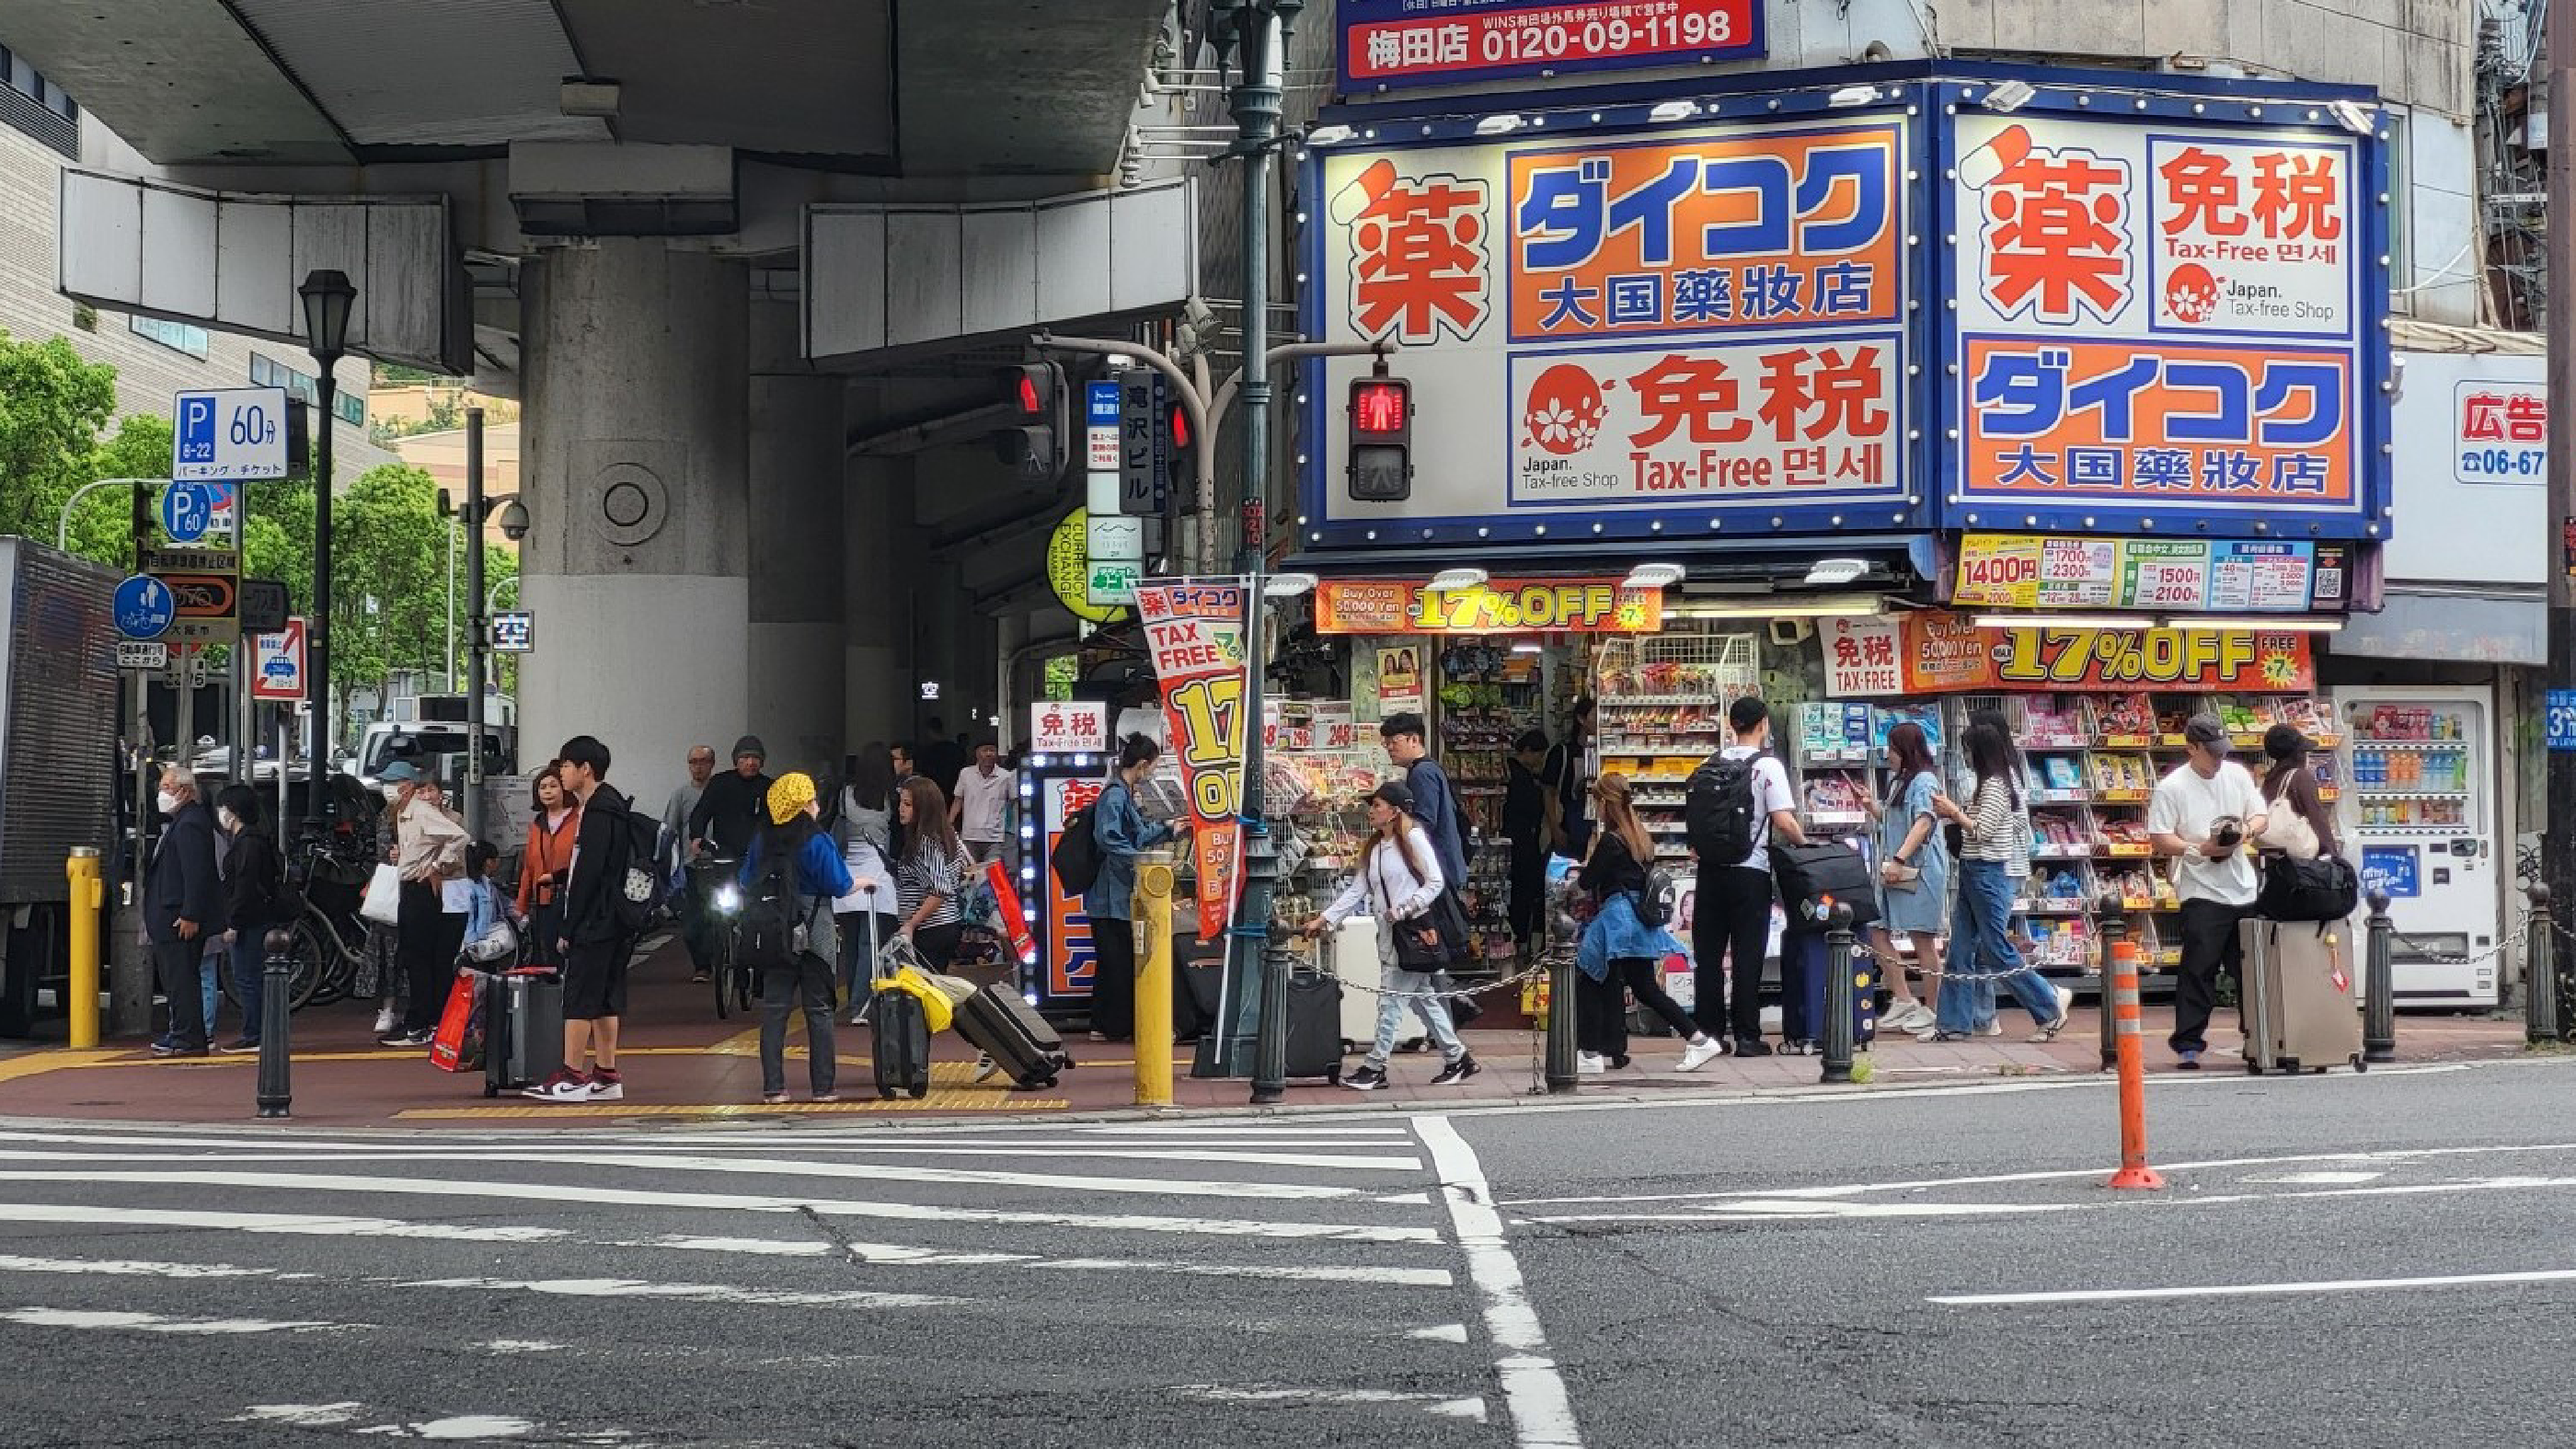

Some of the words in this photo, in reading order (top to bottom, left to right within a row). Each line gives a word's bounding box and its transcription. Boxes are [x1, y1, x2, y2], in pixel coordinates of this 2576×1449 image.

[1367, 23, 1469, 70] 梅田店
[1482, 10, 1731, 62] 0120-09-1198
[1518, 143, 1892, 273] ダイコク
[2159, 147, 2340, 240] 免税
[2165, 237, 2269, 262] Tax-Free
[2275, 243, 2336, 265] 면세
[2226, 299, 2292, 318] Tax-free
[2294, 301, 2333, 322] Shop
[1626, 346, 1890, 449] 免税
[1973, 347, 2343, 446] ダイコク
[188, 402, 208, 438] P
[231, 405, 276, 444] 60分
[2461, 391, 2547, 443] 広告
[1524, 473, 1577, 489] Tax-free
[1582, 471, 1619, 489] Shop
[1629, 449, 1772, 491] Tax-Free
[1783, 443, 1883, 486] 면세
[2483, 449, 2547, 476] 06-67
[172, 491, 192, 532] P
[1060, 523, 1072, 600] EXCHANGE
[1962, 557, 2037, 586] 1400円
[1414, 583, 1613, 627] 17%OFF
[1151, 623, 1200, 647] TAX
[1834, 635, 1894, 668] 免税
[2000, 627, 2255, 682] 17%OFF
[2261, 637, 2296, 650] FREE
[121, 657, 162, 665] ここから
[1157, 645, 1221, 670] FREE
[1041, 712, 1098, 736] 免税
